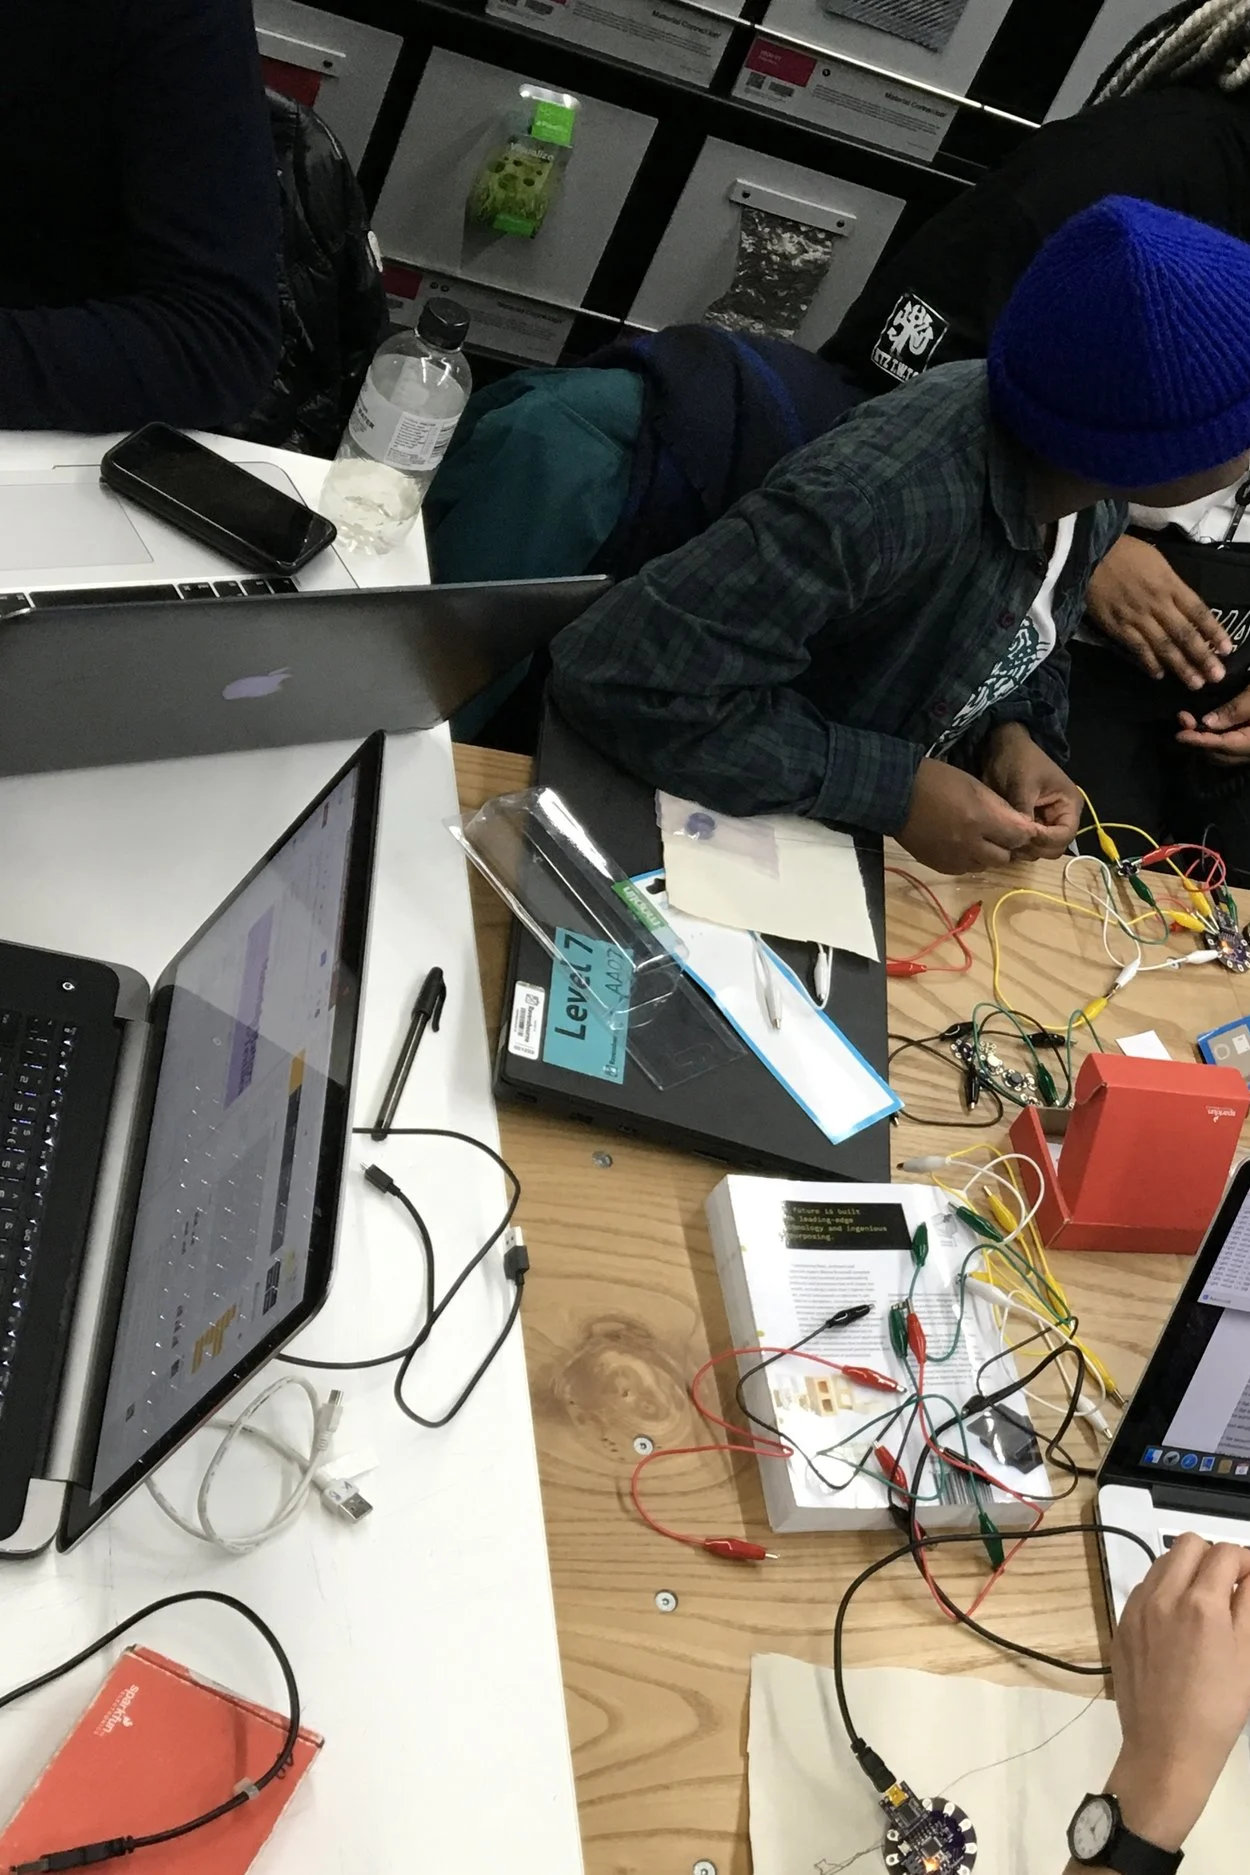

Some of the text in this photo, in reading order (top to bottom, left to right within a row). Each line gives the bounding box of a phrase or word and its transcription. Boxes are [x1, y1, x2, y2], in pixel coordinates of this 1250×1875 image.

[622, 886, 663, 930] maplin
[554, 933, 593, 1041] Level 7
[837, 1207, 861, 1215] built
[846, 1225, 888, 1233] ingenious
[102, 1684, 140, 1733] sparkfun
